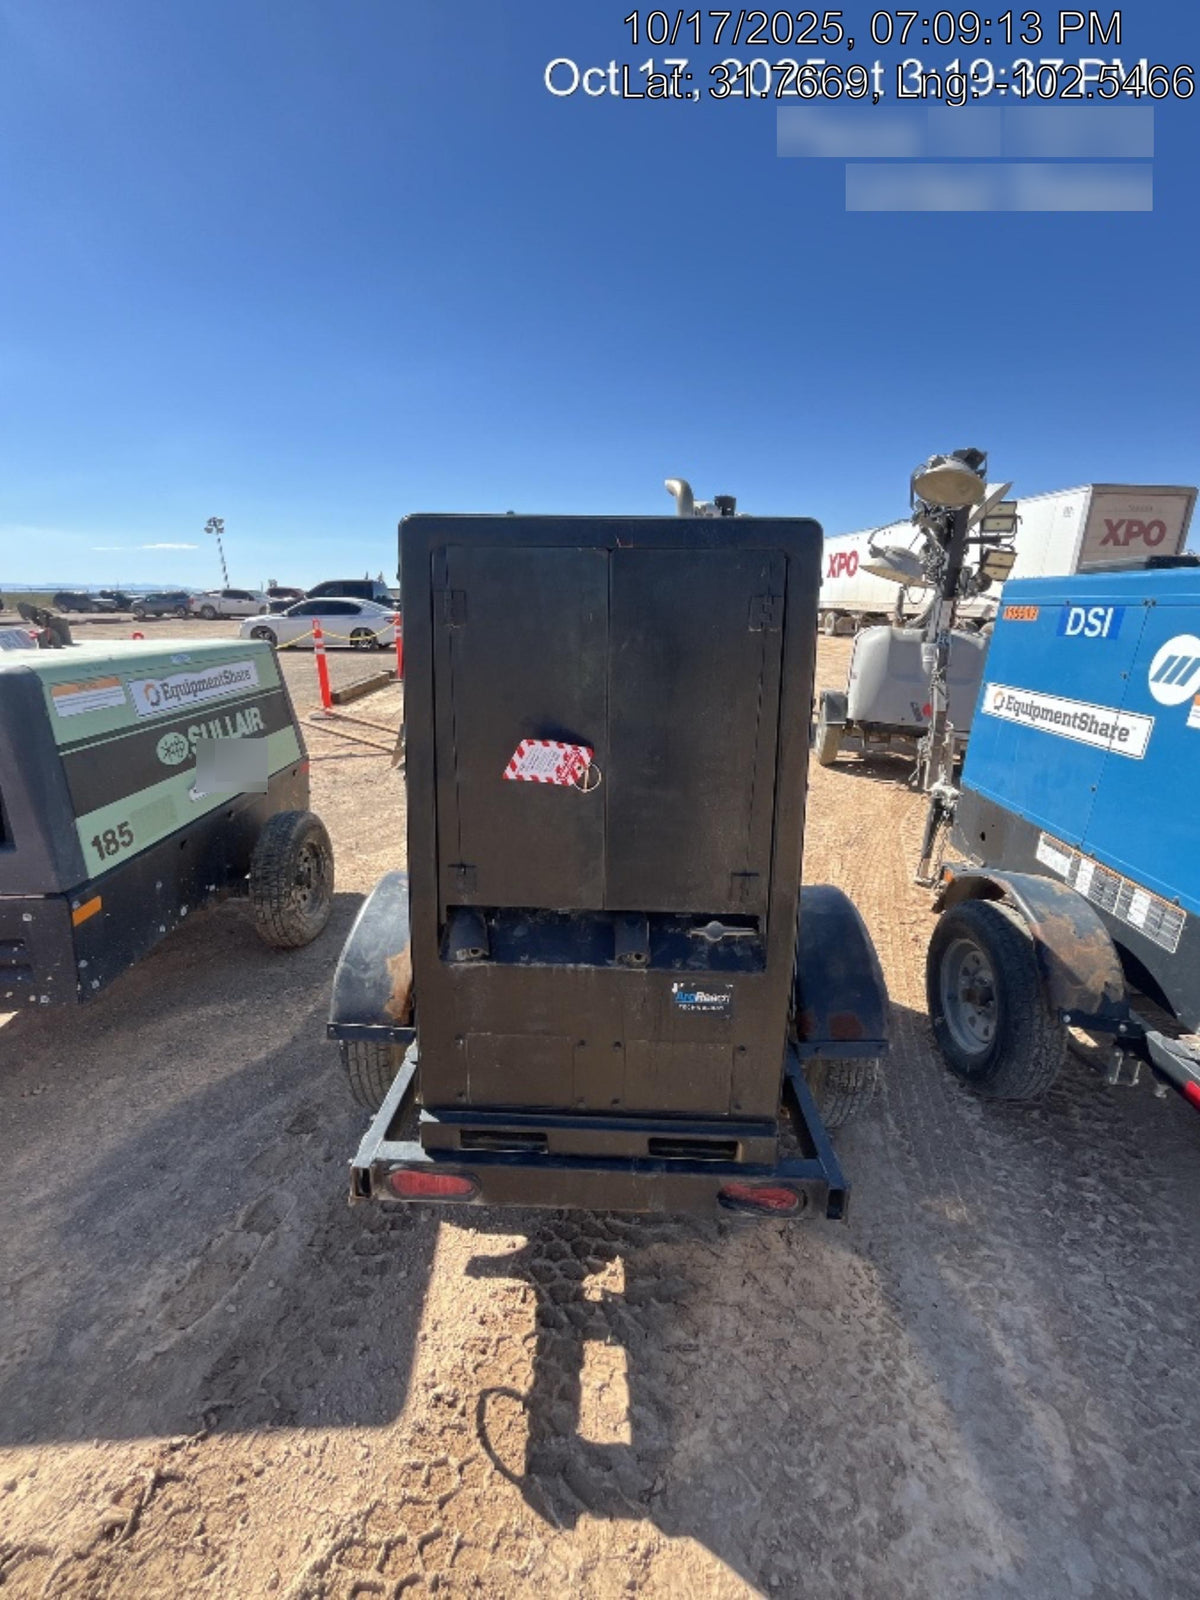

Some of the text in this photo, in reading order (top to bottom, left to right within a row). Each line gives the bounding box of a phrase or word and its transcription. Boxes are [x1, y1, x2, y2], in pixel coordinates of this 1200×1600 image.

[1099, 518, 1167, 547] XPO
[826, 549, 859, 578] XPO
[1064, 606, 1114, 638] DSI
[159, 669, 252, 701] EquipmentShare
[1004, 694, 1131, 743] EquipmentShare
[91, 820, 134, 861] 185
